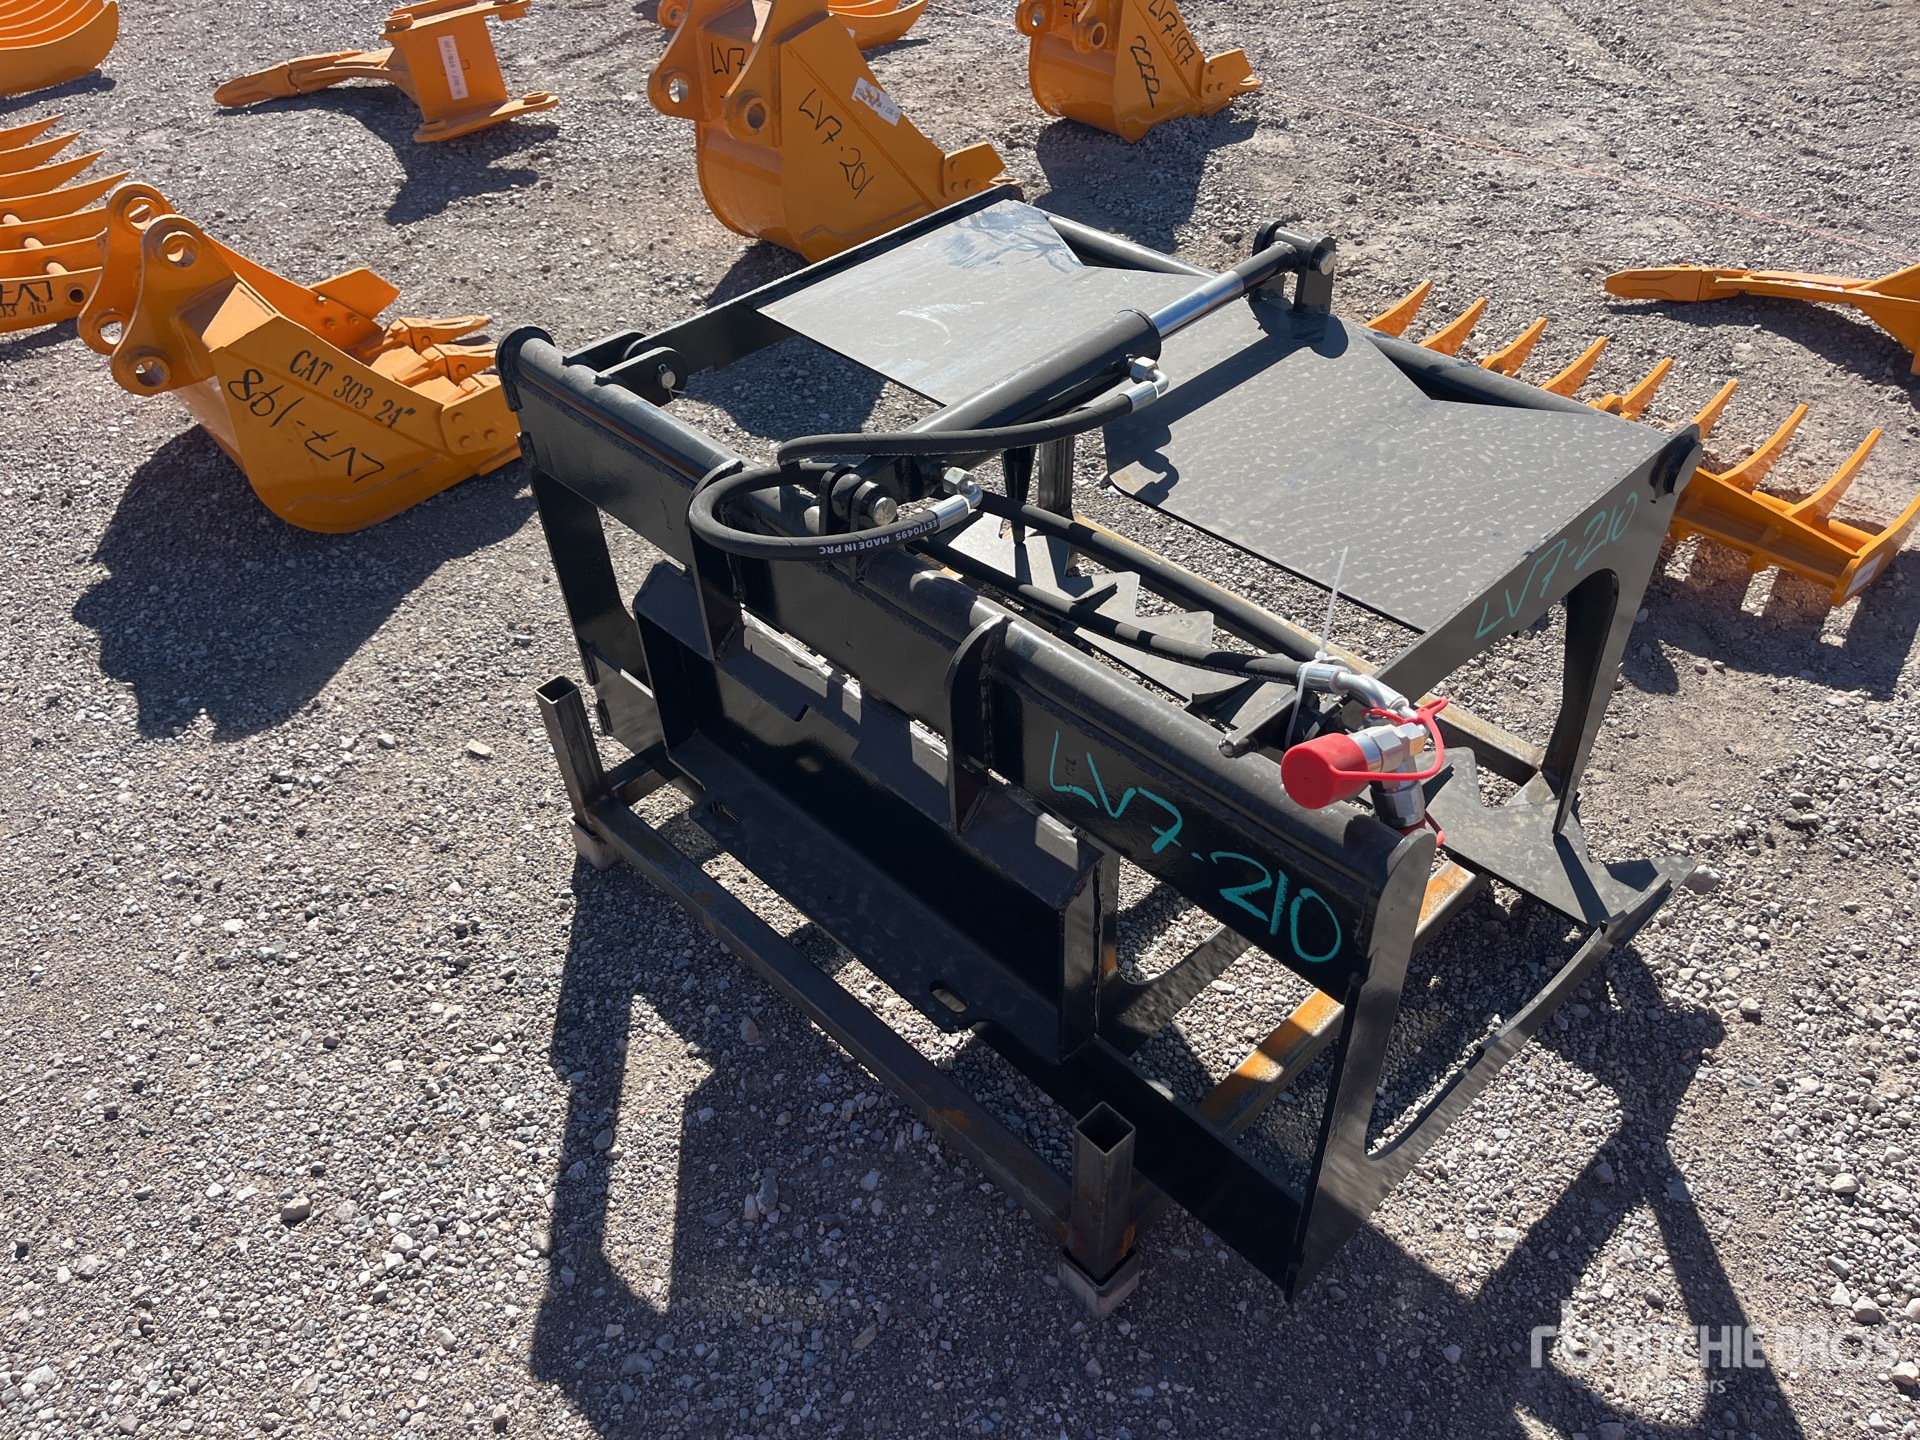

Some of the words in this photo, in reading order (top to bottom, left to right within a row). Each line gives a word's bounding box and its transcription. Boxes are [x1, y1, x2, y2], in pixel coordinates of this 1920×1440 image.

[289, 350, 334, 385] CAT
[333, 375, 374, 410] 303
[895, 520, 938, 542] EE170495
[819, 544, 842, 555] PRC
[843, 542, 857, 552] IN
[858, 535, 890, 551] MADE
[1474, 491, 1638, 640] LV7-210
[1049, 730, 1341, 962] LV7-210
